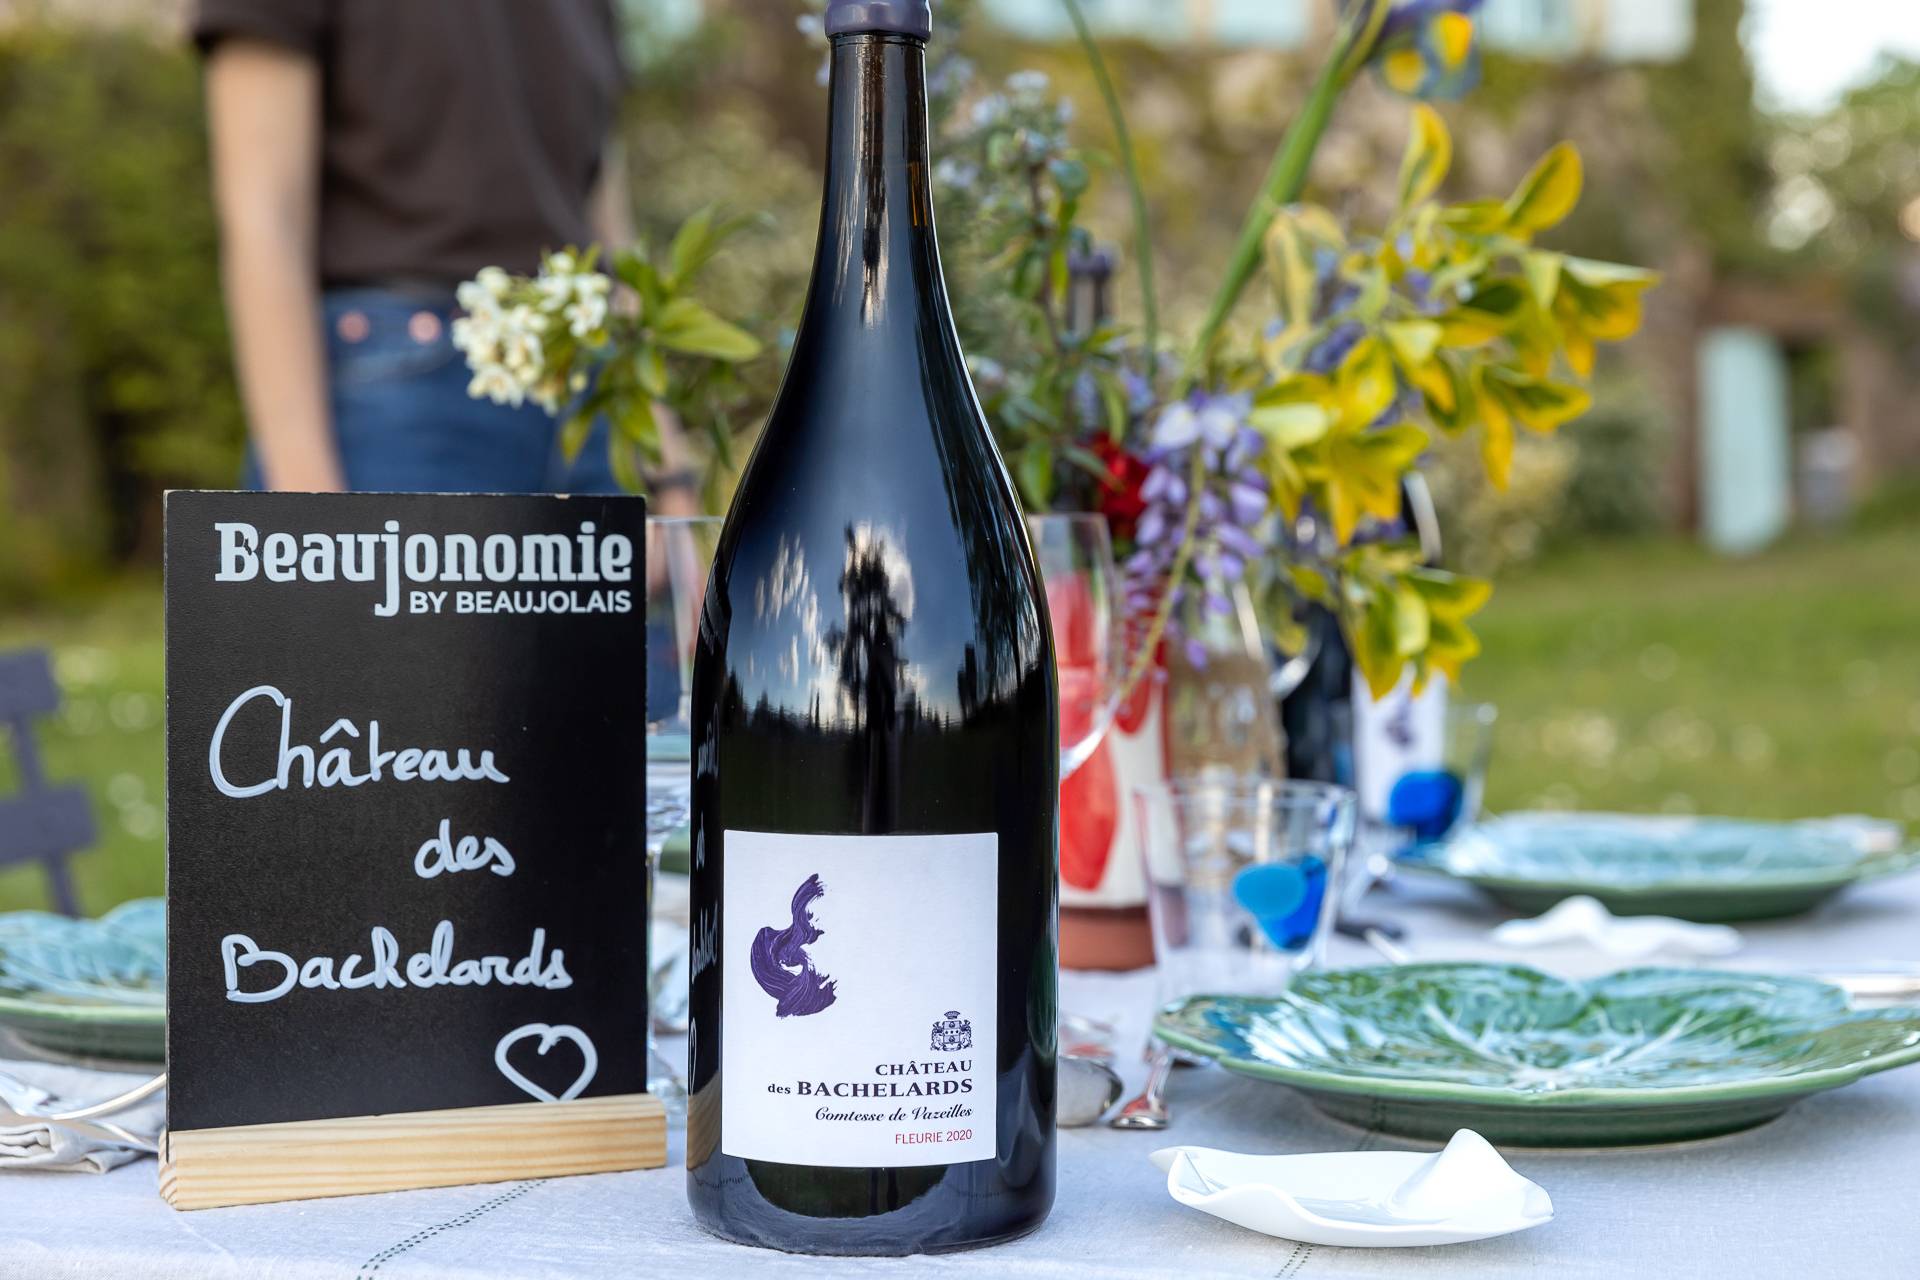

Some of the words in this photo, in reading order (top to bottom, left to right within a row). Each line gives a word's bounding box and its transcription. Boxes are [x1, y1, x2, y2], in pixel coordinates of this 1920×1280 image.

[215, 520, 632, 617] Beaujonomie
[409, 590, 448, 614] BY
[456, 590, 632, 614] BEAUJOLAIS
[208, 685, 510, 799] Château
[414, 818, 516, 879] des
[221, 919, 573, 1003] Bachelards
[875, 1059, 972, 1076] CHÂTEAU
[767, 1083, 791, 1095] des
[797, 1078, 973, 1098] BACHELARDS
[815, 1106, 884, 1122] Comtesse
[888, 1107, 907, 1122] de
[911, 1103, 972, 1121] Vazeilles
[895, 1131, 943, 1145] FLEURIE
[946, 1128, 973, 1143] 2020
